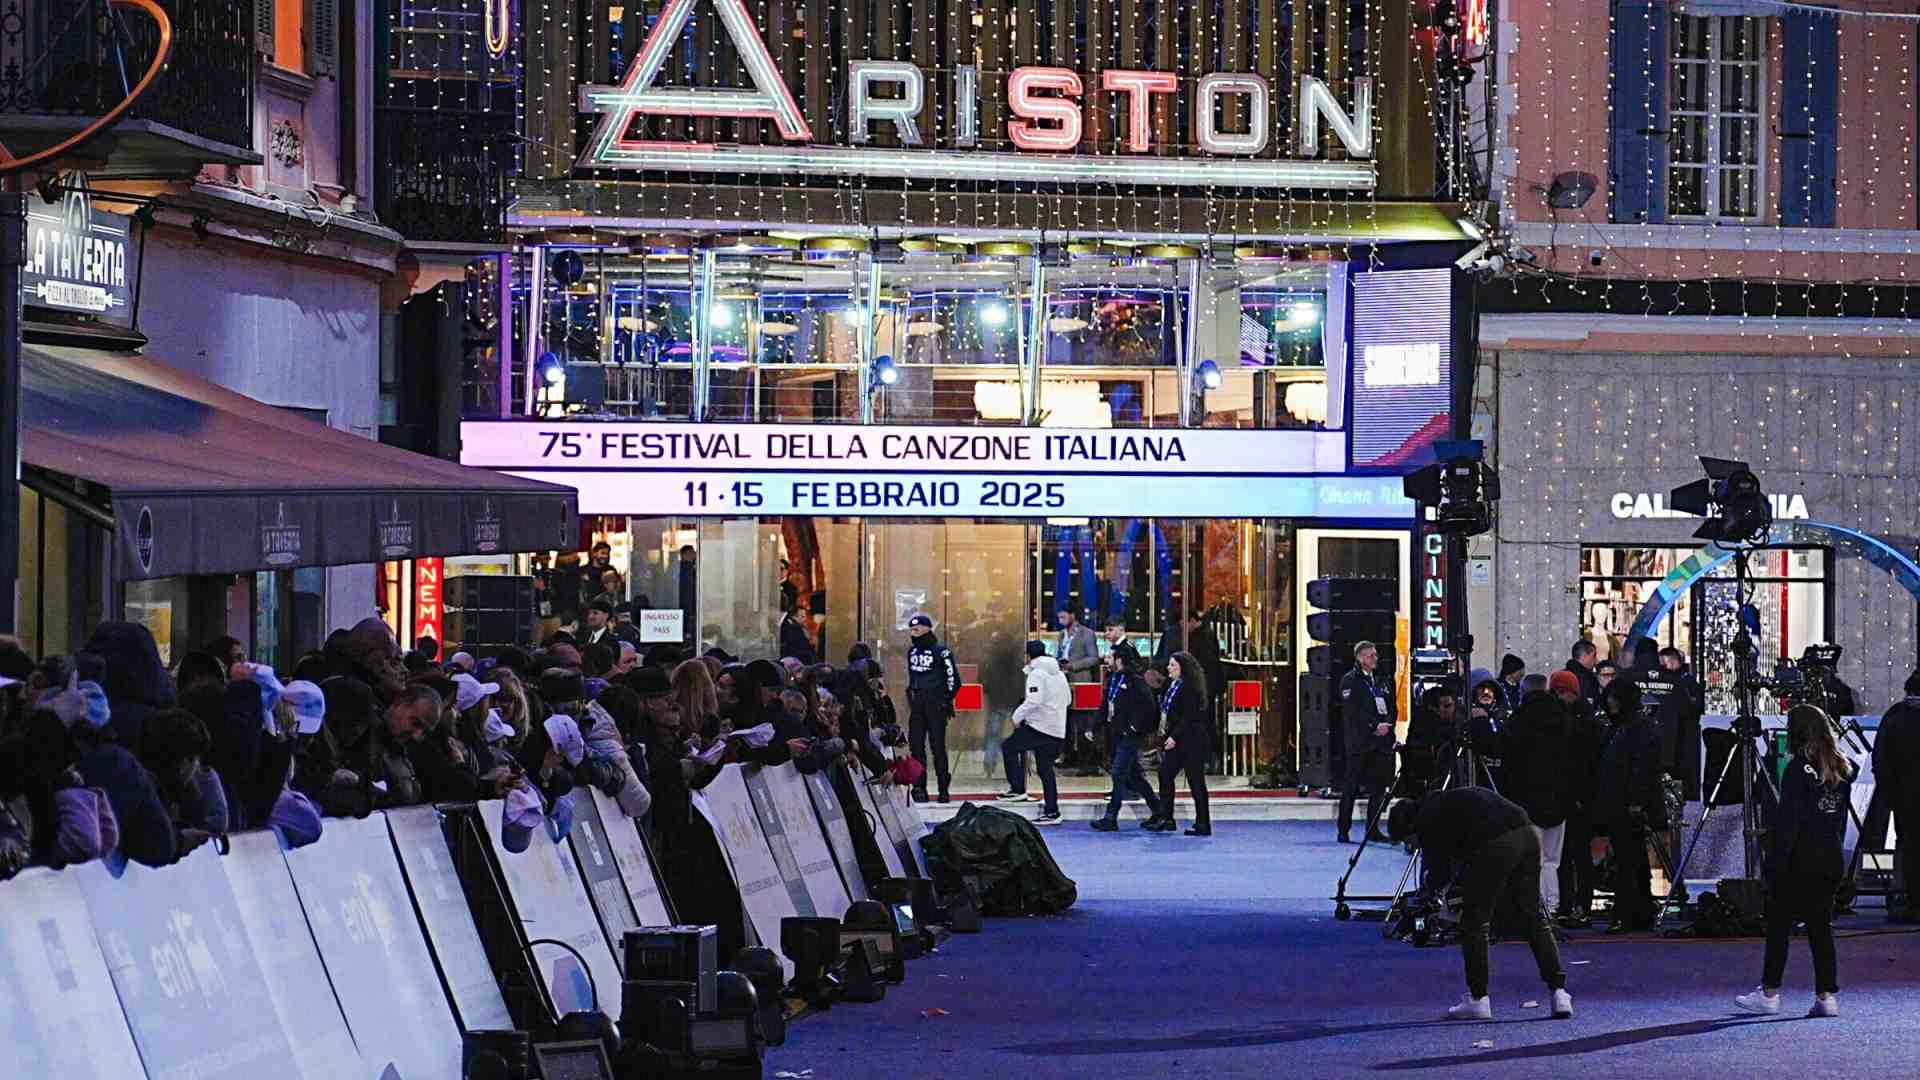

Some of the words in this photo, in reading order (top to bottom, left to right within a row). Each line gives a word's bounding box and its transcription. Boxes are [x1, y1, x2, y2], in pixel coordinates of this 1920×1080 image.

[578, 0, 1376, 168] ARISTON
[51, 231, 125, 288] TAVERNA
[601, 432, 751, 459] FESTIVAL
[767, 433, 868, 459] DELLA
[882, 434, 1031, 461] CANZONE
[1045, 435, 1186, 462] ITALIANA
[791, 481, 960, 508] FEBBRAIO
[979, 481, 1065, 508] 2025
[1425, 534, 1442, 647] CINEM
